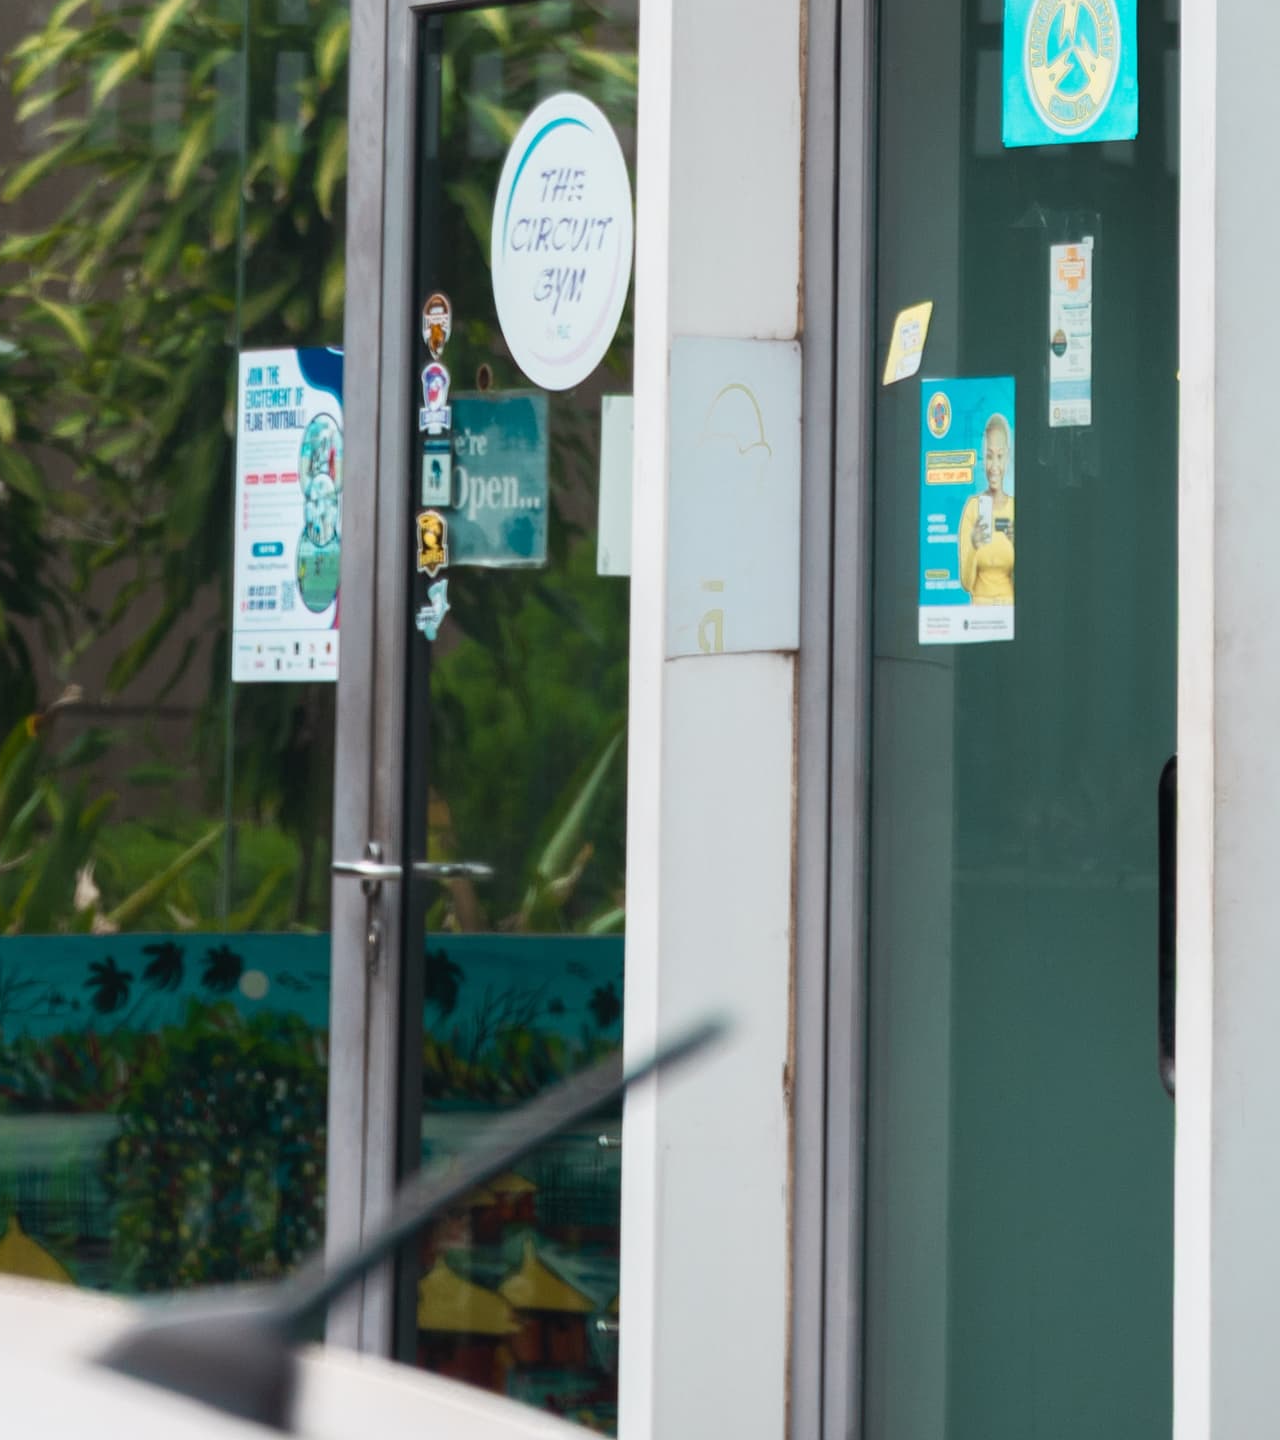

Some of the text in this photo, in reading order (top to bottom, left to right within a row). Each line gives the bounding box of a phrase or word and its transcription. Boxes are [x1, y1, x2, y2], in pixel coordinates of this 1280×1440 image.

[541, 167, 586, 203] THE
[510, 216, 614, 253] CIRCUIT
[533, 266, 587, 316] GYM
